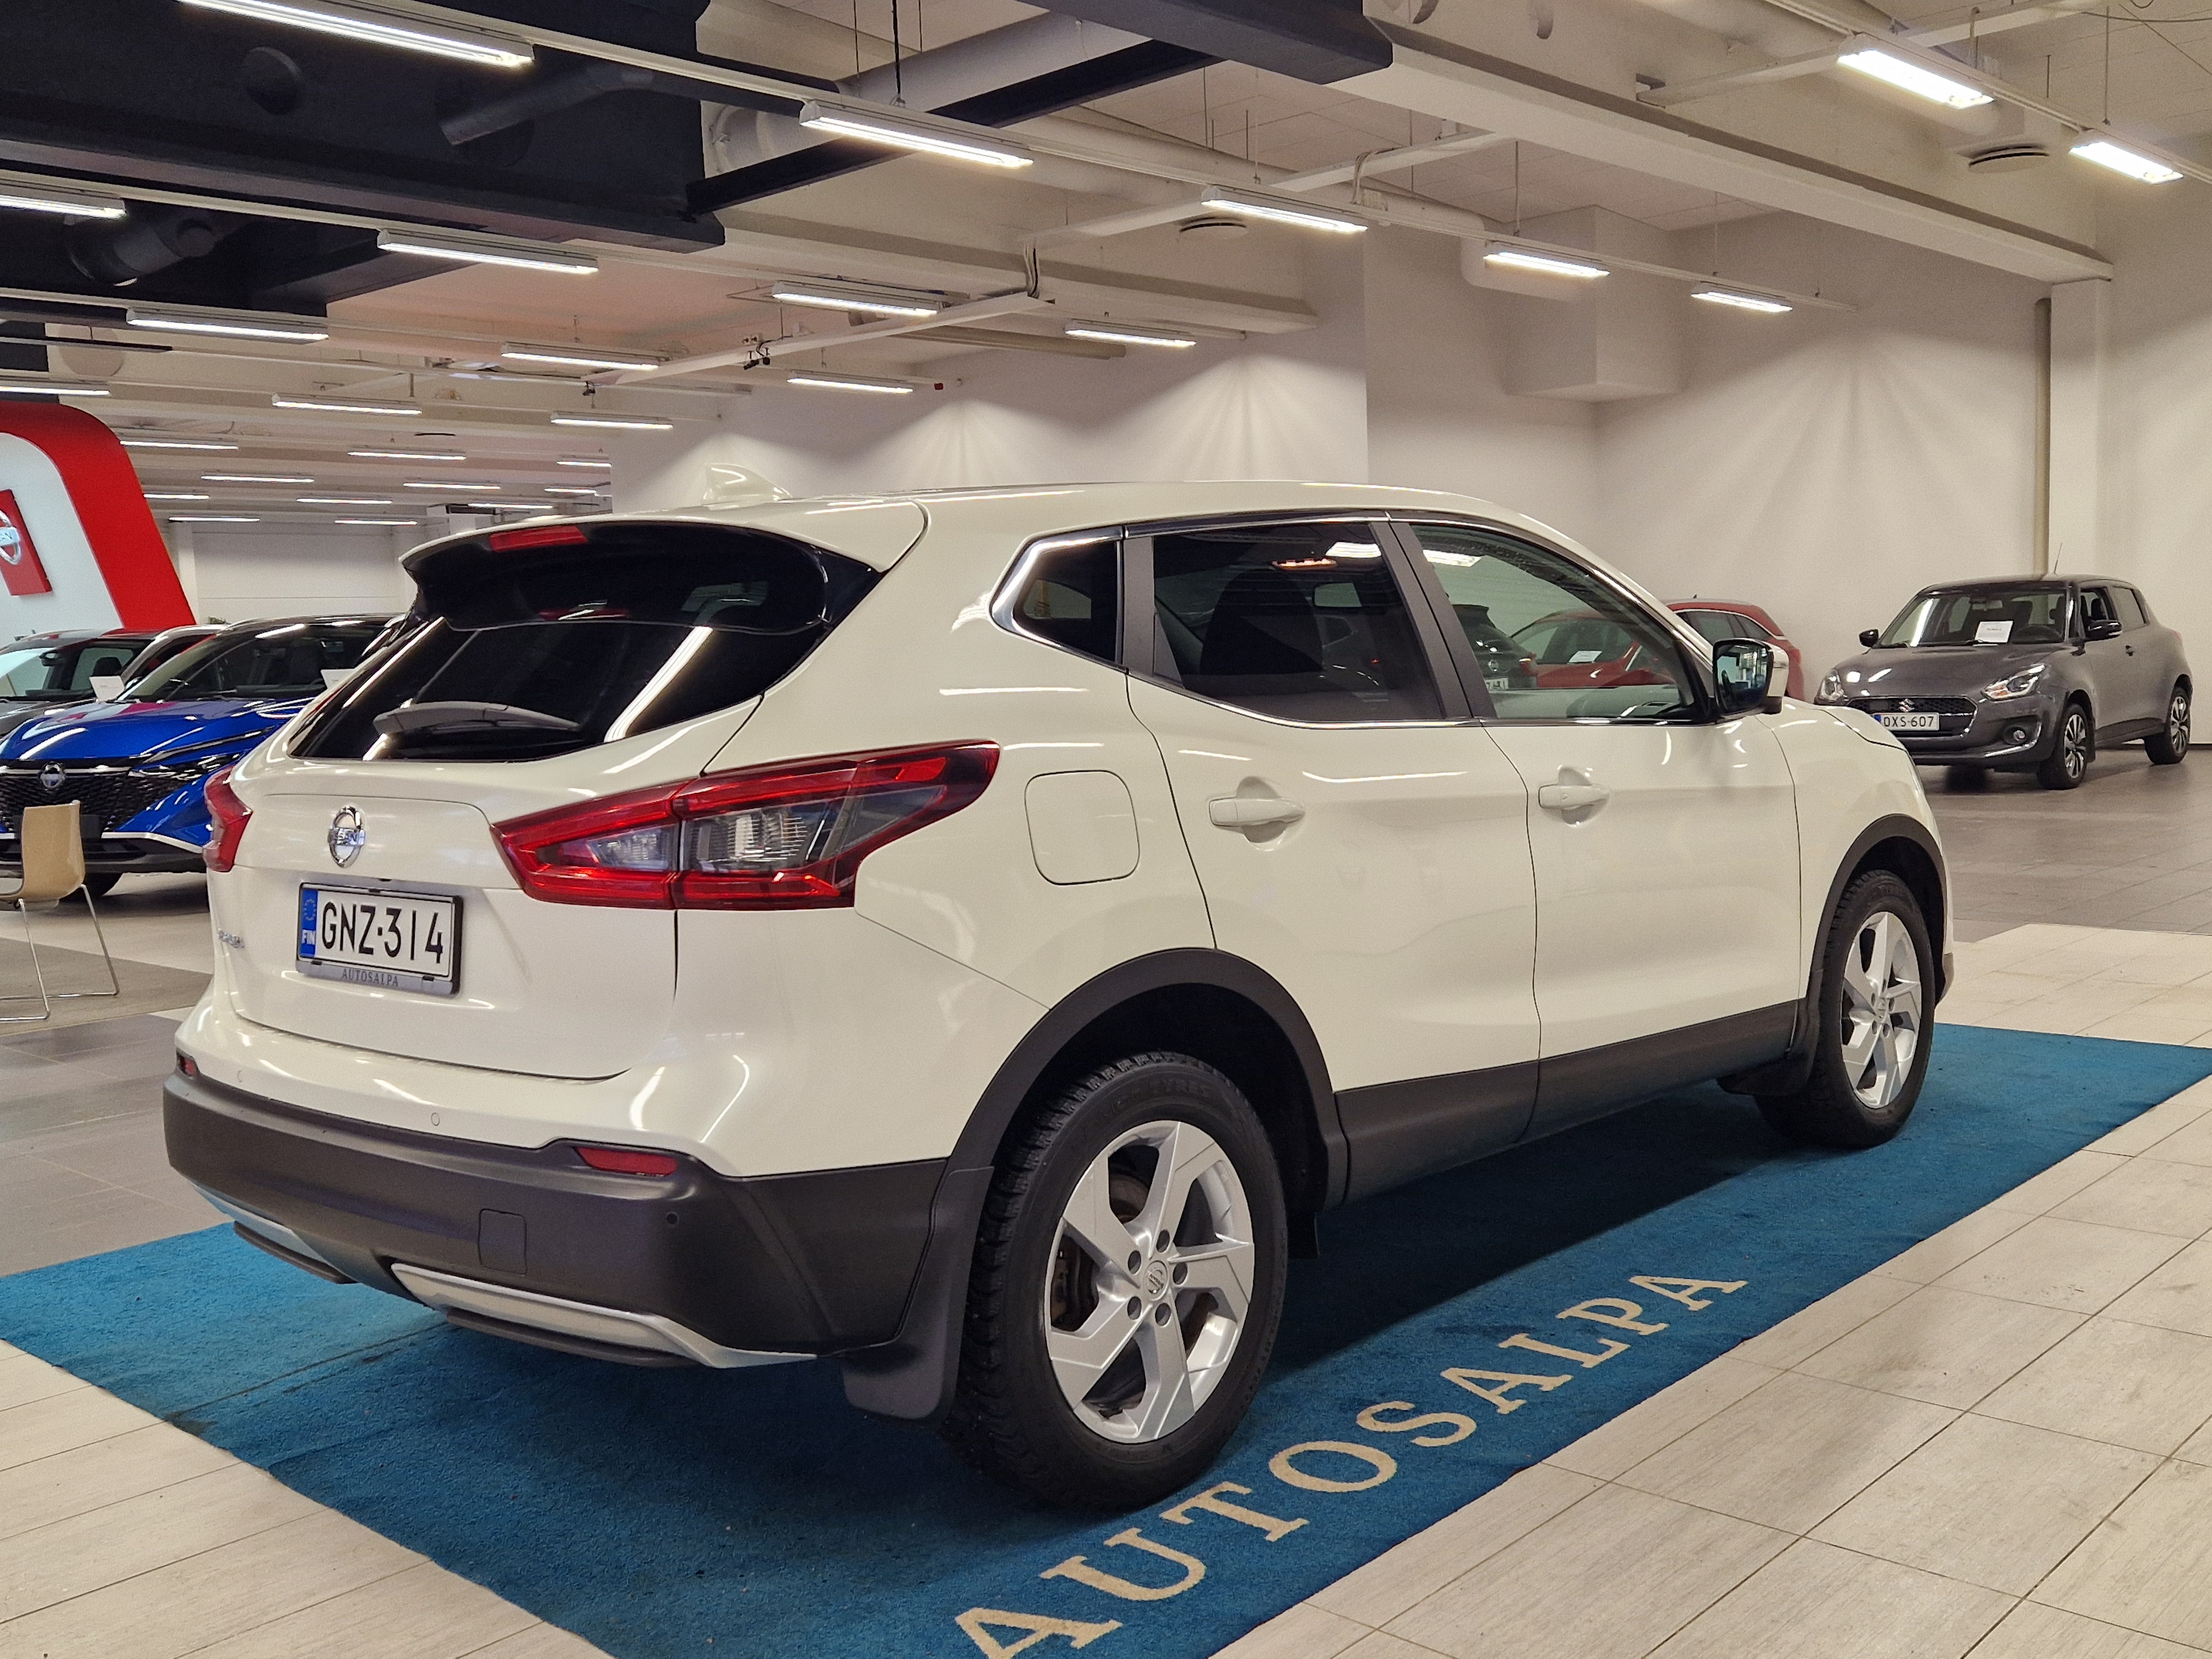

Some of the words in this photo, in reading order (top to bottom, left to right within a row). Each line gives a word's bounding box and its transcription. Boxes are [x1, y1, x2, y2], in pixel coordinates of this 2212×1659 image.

[1884, 716, 1934, 727] OXS-607
[301, 929, 316, 945] FIN
[322, 901, 444, 963] GNZ-314
[341, 968, 398, 987] AUTOSALPA
[954, 1275, 1749, 1659] AUTOSALPA
